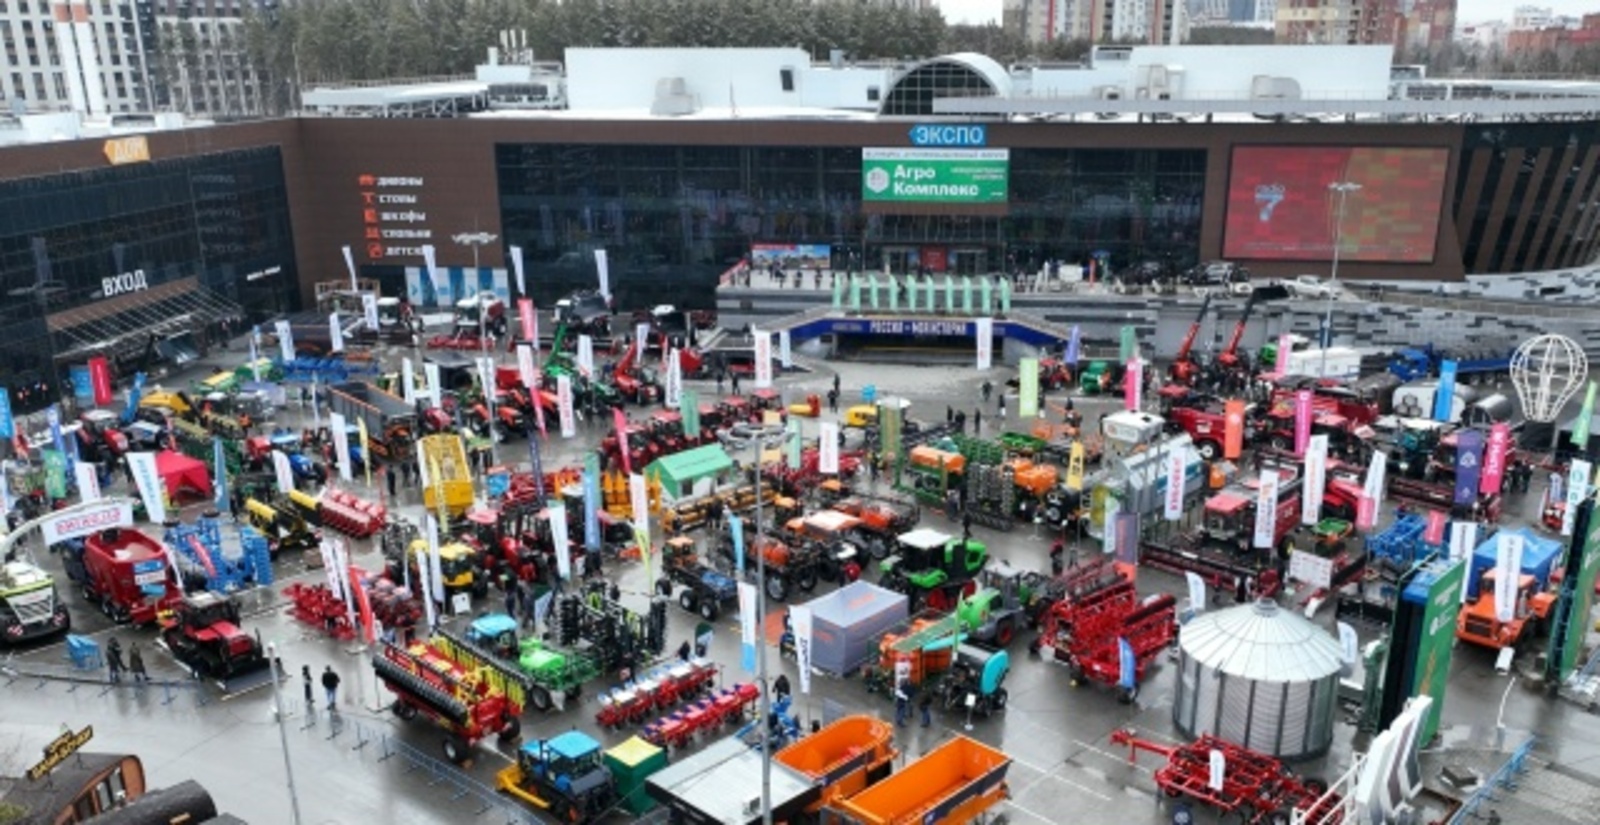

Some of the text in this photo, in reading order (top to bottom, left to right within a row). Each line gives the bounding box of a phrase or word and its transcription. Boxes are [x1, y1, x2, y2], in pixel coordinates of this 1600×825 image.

[916, 126, 984, 144] ЭКСПО
[893, 165, 936, 183] Агро
[893, 182, 980, 197] Комплекс
[101, 269, 149, 297] ВХОД
